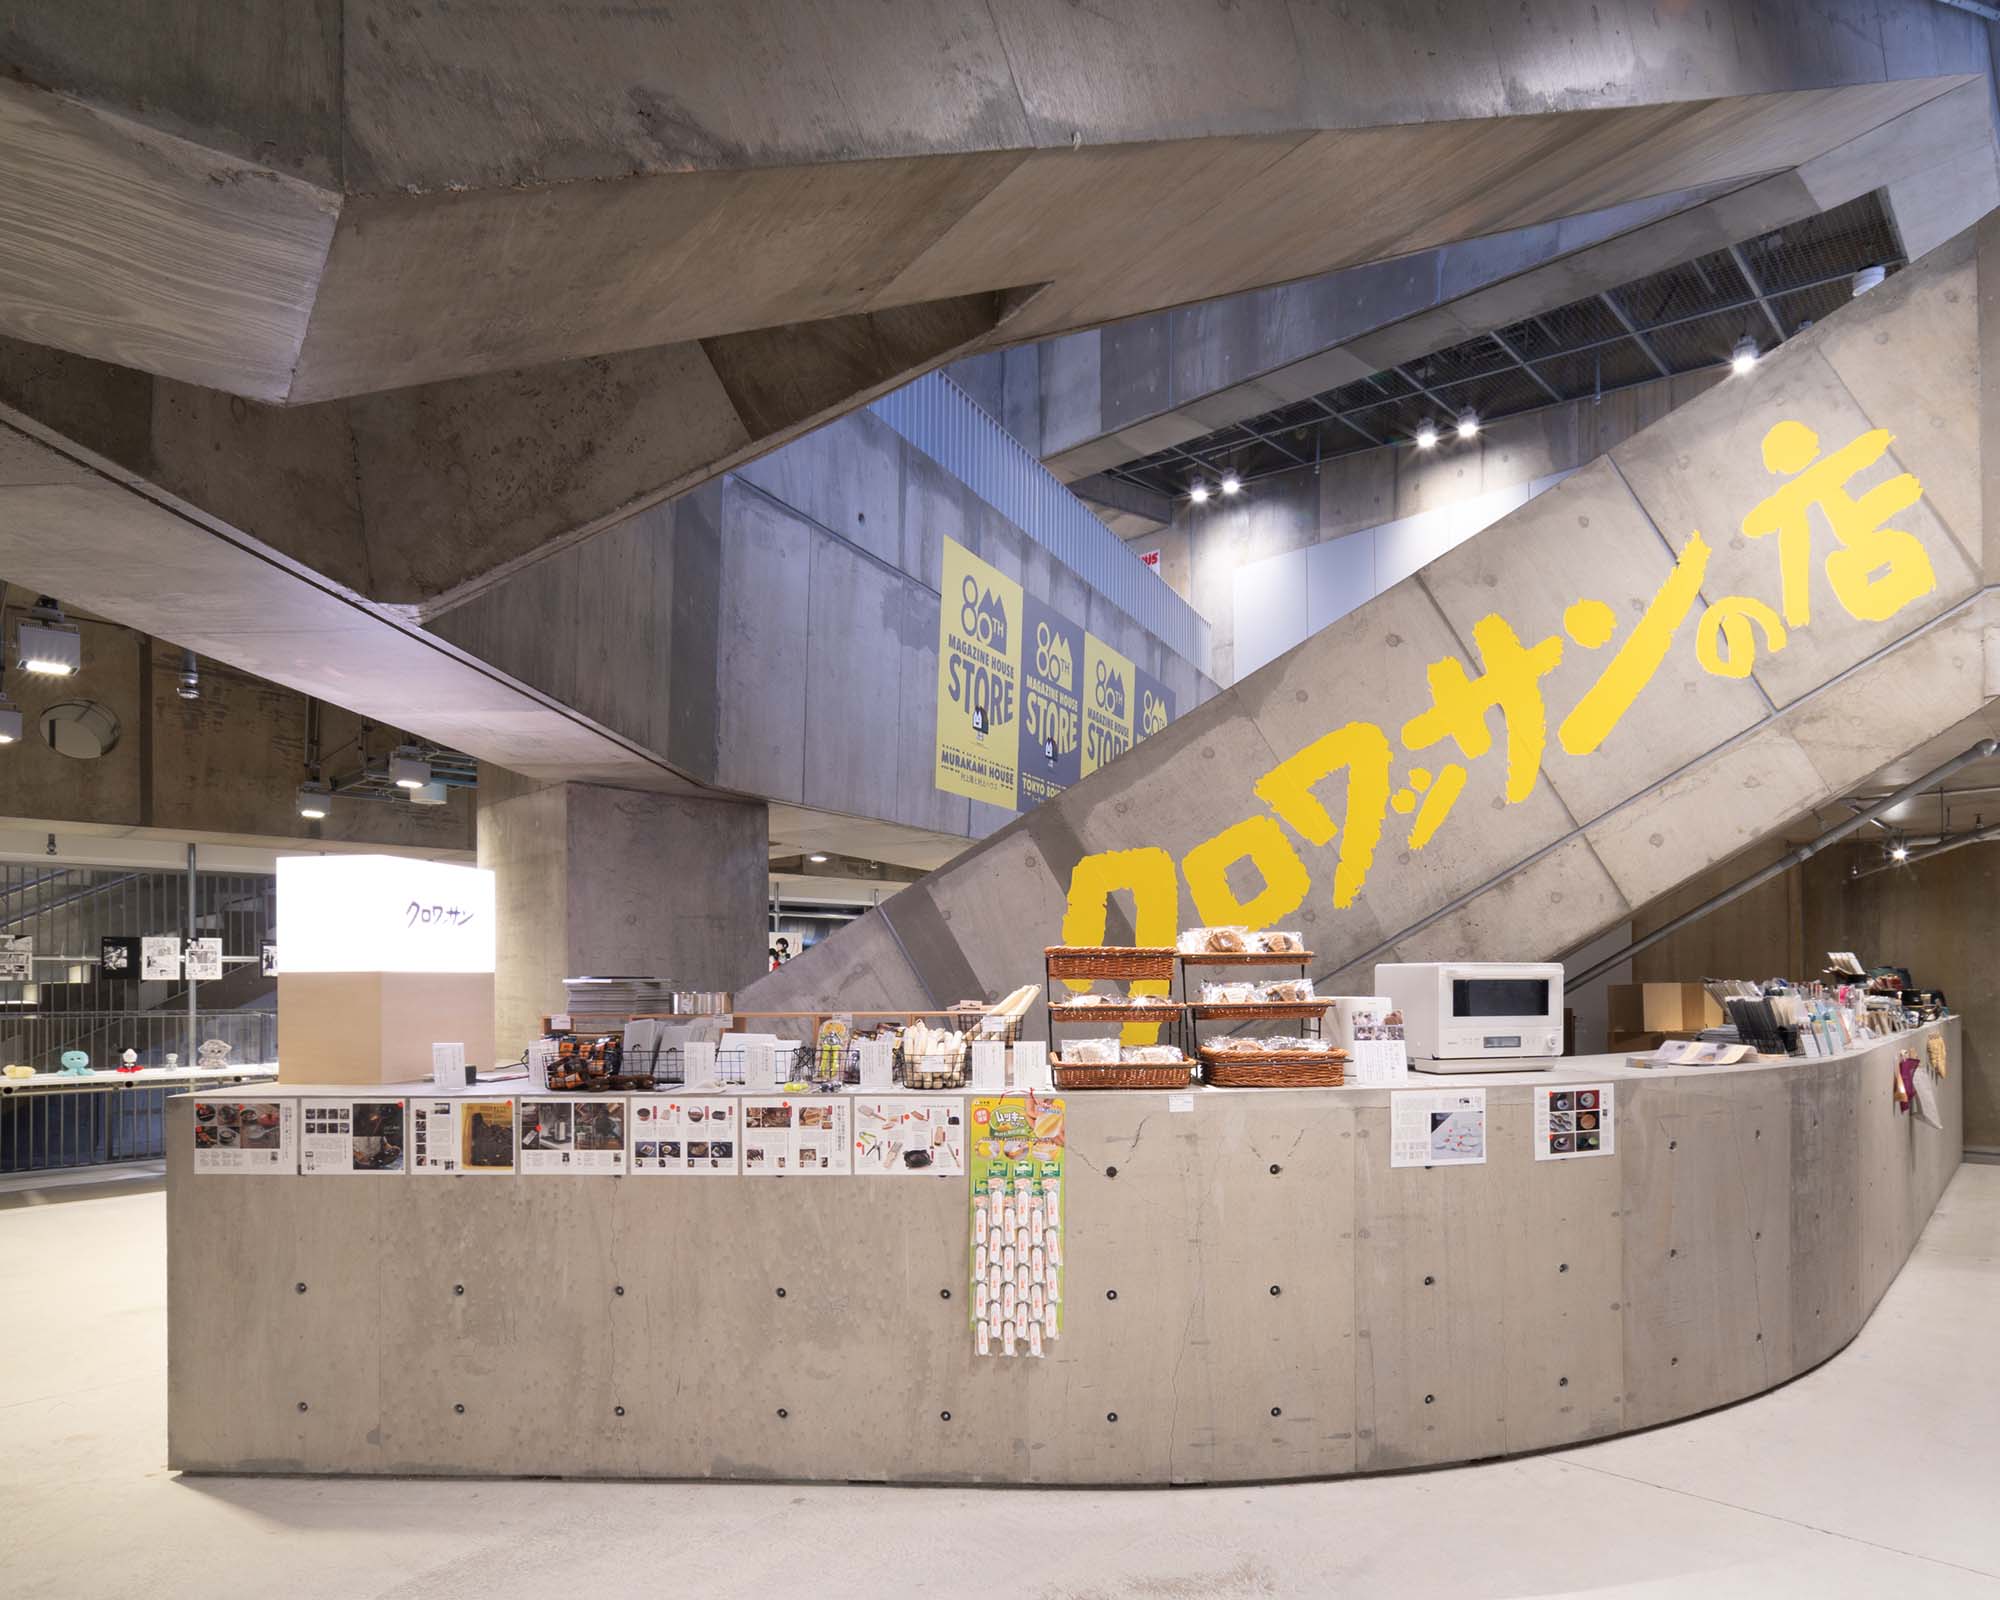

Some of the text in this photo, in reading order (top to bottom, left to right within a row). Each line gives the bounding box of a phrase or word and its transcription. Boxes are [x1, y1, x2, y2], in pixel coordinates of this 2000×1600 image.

[948, 633, 1014, 679] MAGAZINE HOUSE
[948, 653, 1014, 726] STORE
[1026, 691, 1078, 755] STORE
[1062, 420, 1937, 1045] クロワッサンの店
[941, 750, 987, 777] MURAKAMI
[989, 765, 1014, 785] HOUSE
[1022, 777, 1045, 796] TOKYO
